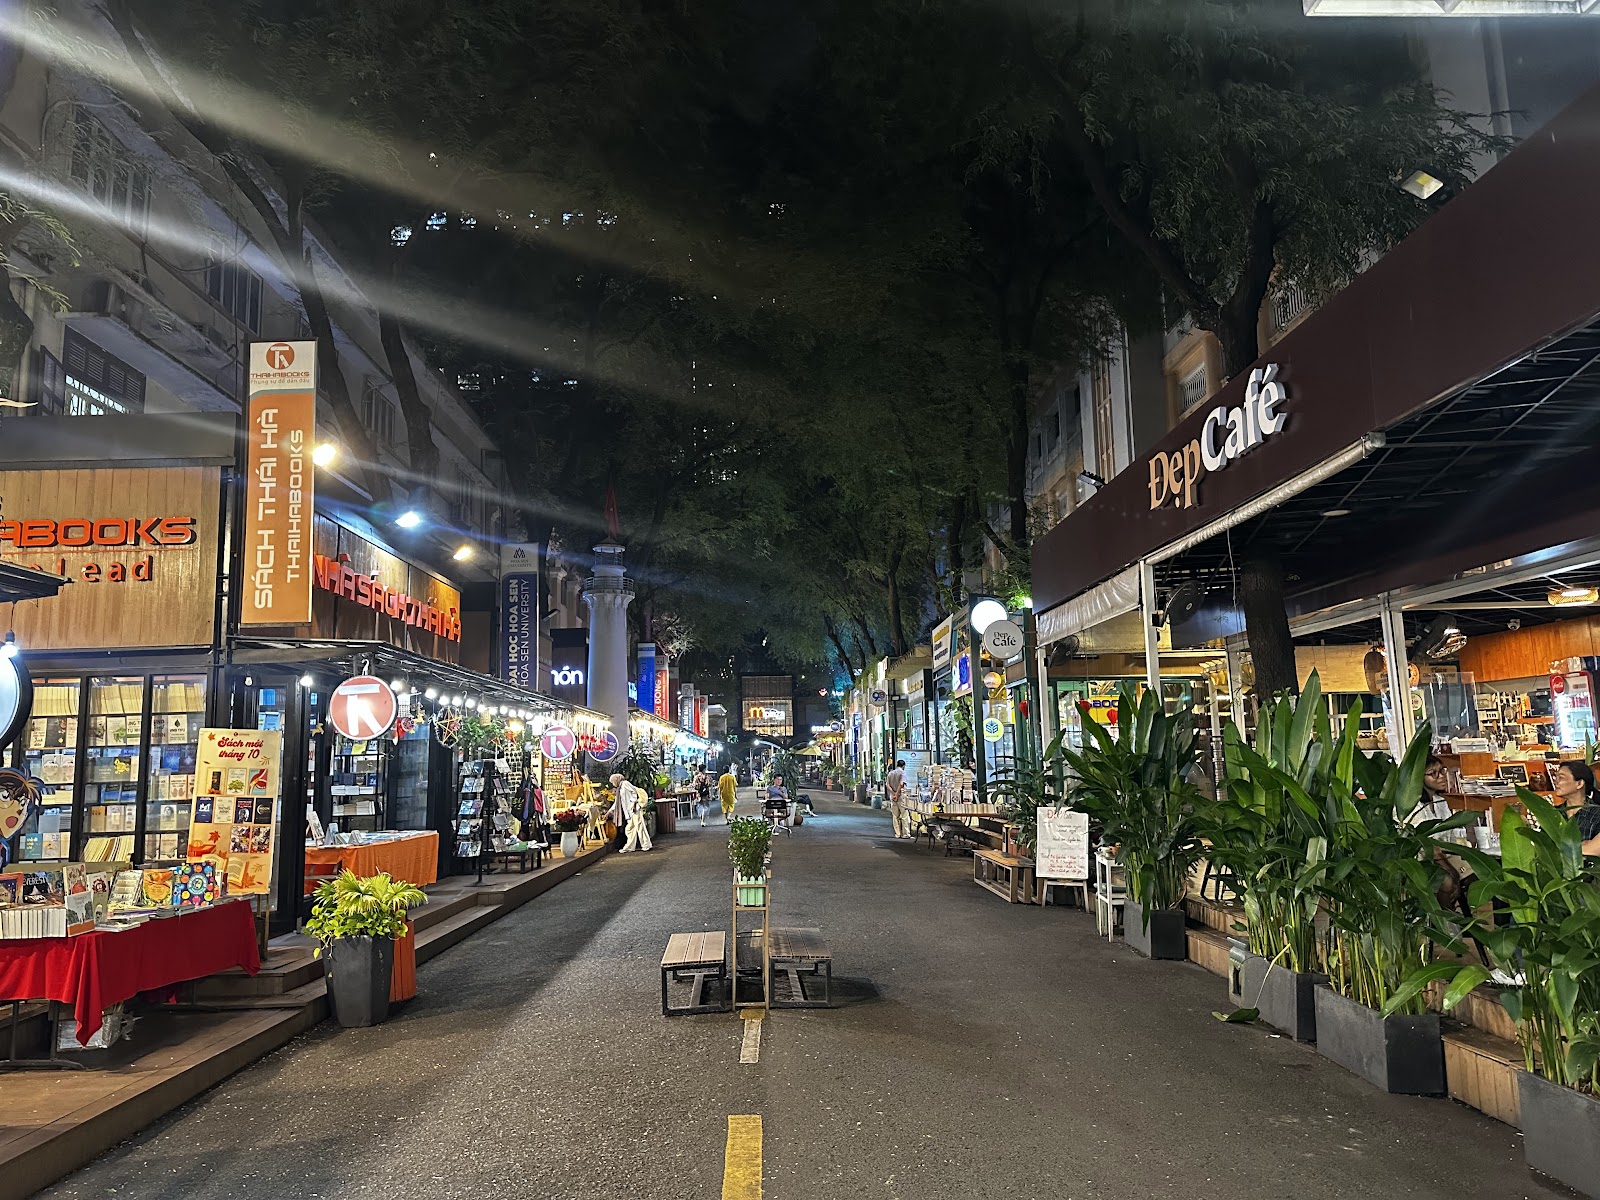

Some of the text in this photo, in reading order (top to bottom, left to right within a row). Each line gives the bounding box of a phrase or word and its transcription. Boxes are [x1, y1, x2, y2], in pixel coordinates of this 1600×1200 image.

[1148, 362, 1288, 511] Đẹp Café
[250, 408, 279, 609] SÁCH THÁI HÀ
[286, 429, 304, 584] THAIHABOOKS
[313, 553, 356, 602] NHÀ
[355, 569, 408, 622] SÁCH
[509, 579, 519, 603] SEN
[508, 605, 520, 633] HOA
[520, 579, 530, 687] HOA SEN UNIVERSITY
[508, 635, 521, 663] HỌC
[992, 636, 1017, 647] Café
[217, 736, 264, 748] Sách mới
[218, 748, 260, 761] tháng 10
